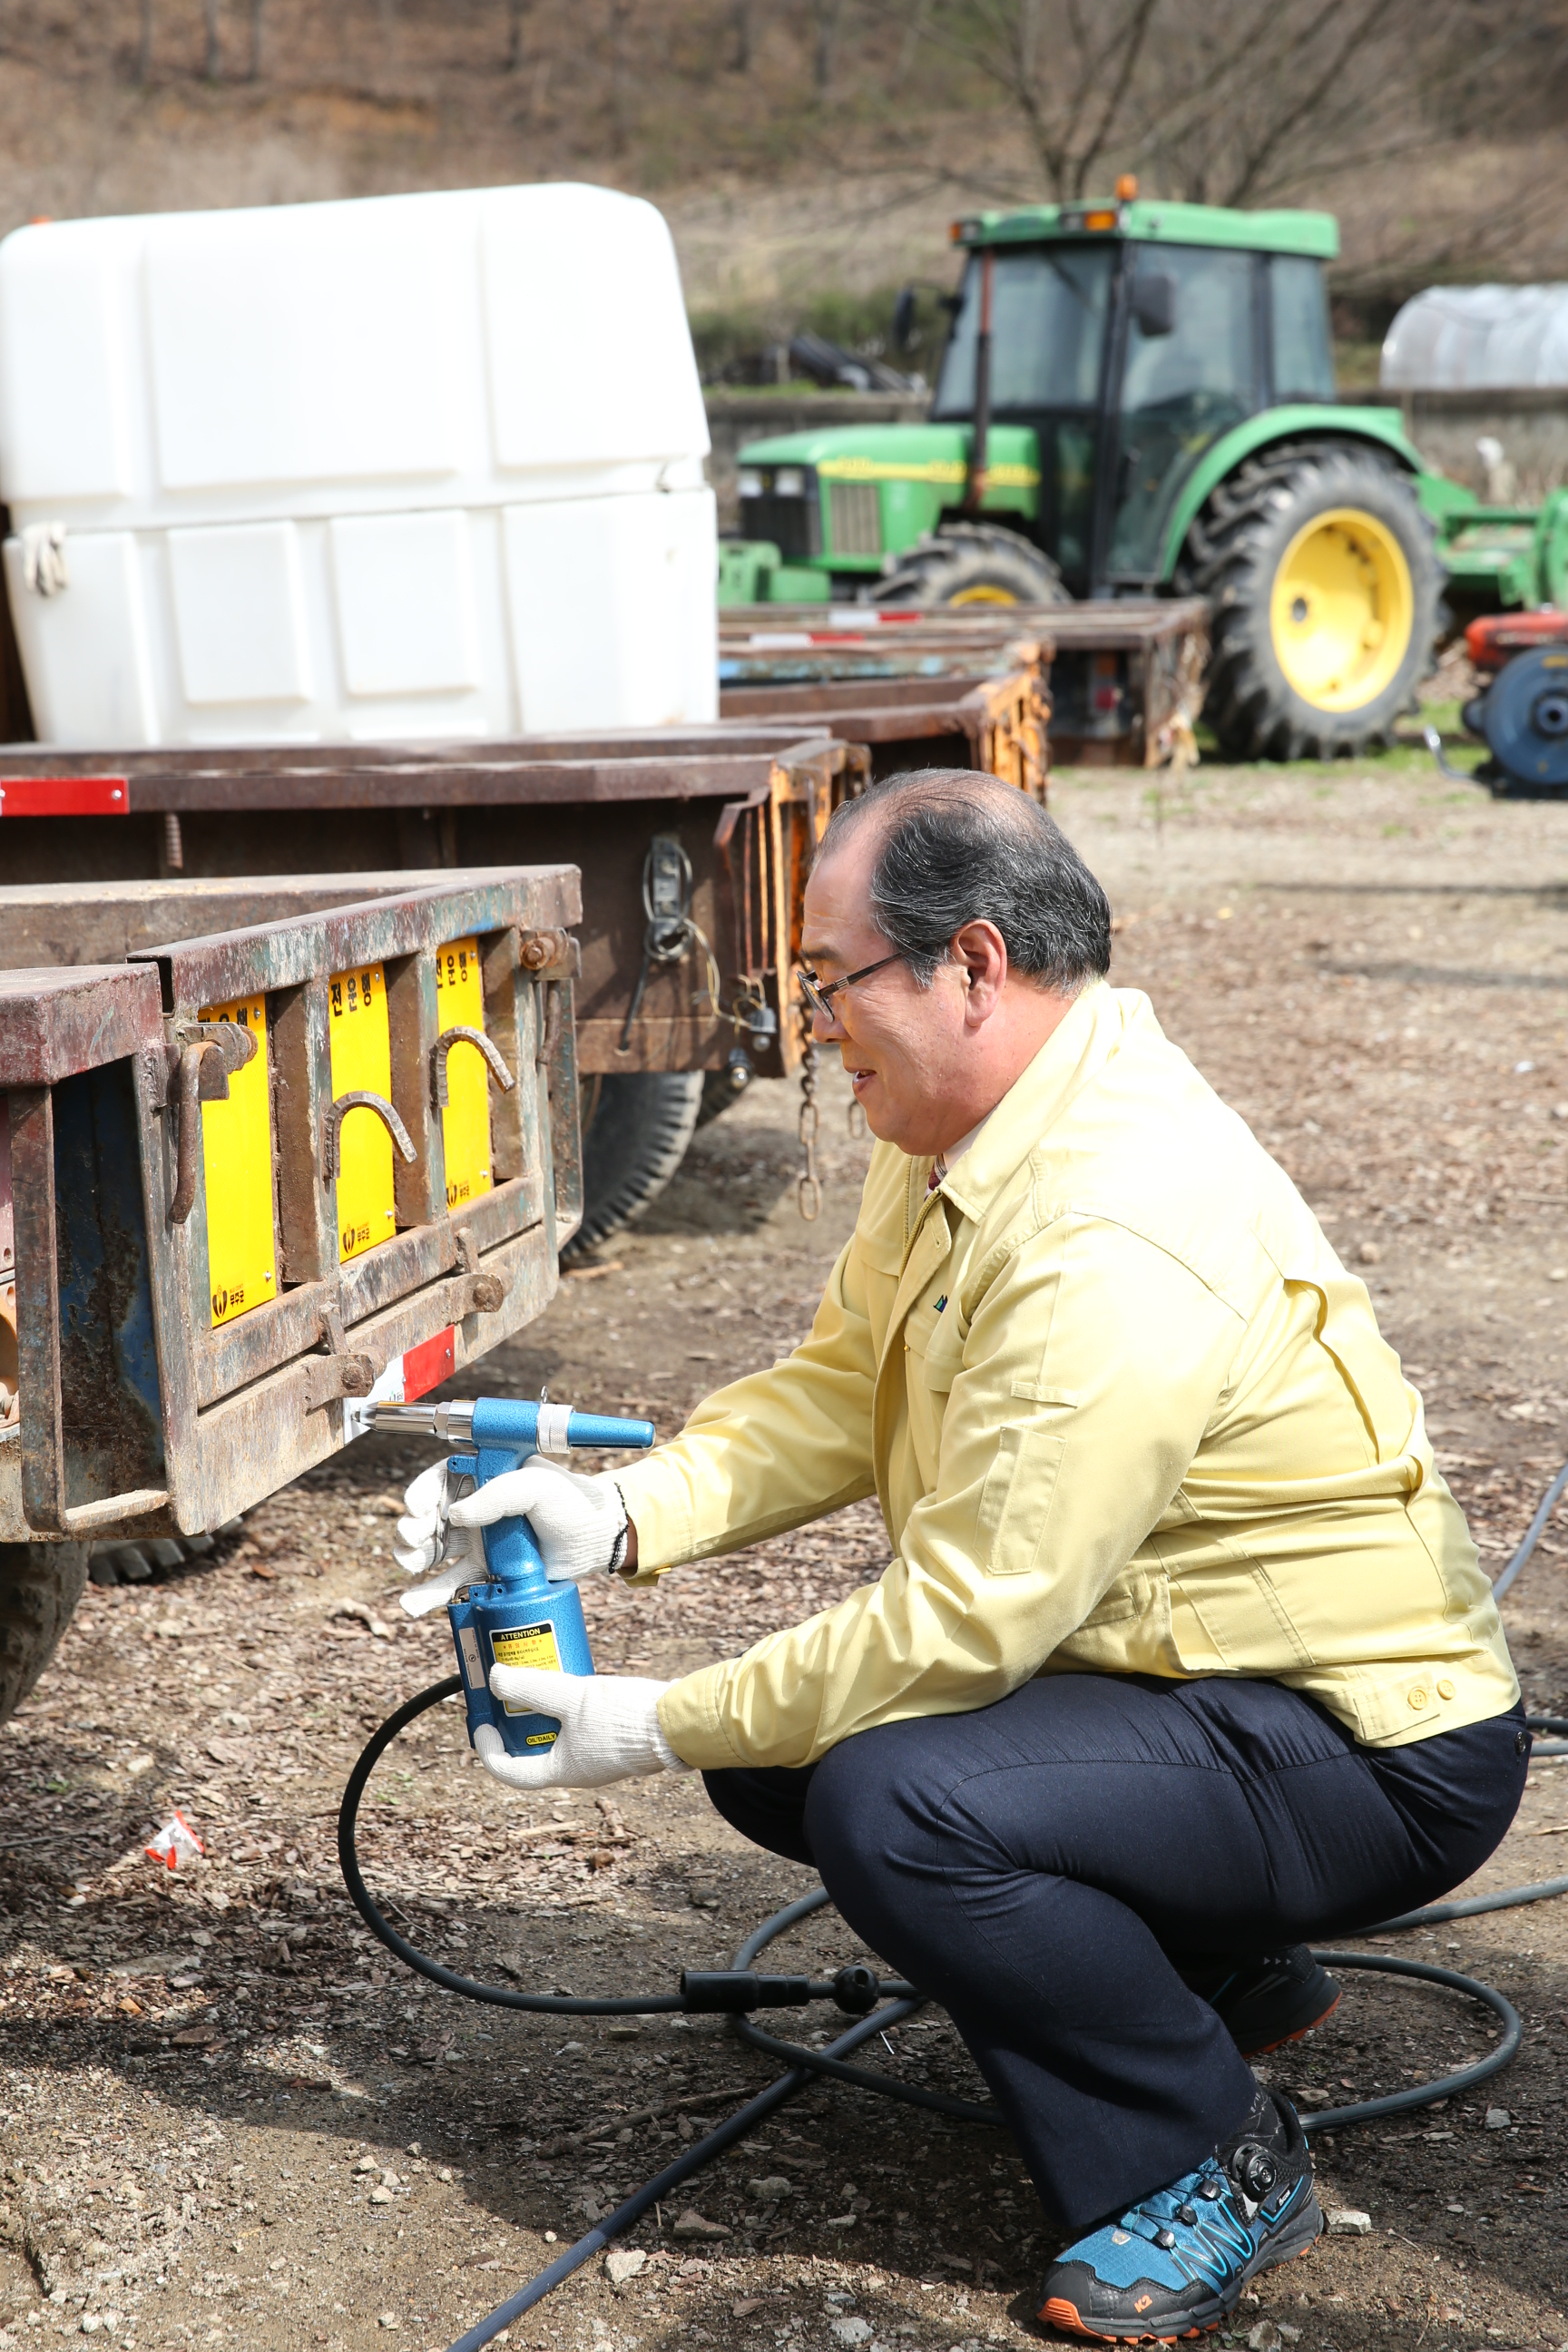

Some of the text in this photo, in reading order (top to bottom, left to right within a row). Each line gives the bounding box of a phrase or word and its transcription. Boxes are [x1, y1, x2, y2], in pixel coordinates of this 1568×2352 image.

[230, 1289, 245, 1308] 무주군
[501, 1627, 541, 1641] ATTENTION
[537, 1733, 555, 1742] DAILY
[1133, 2294, 1153, 2314] K2
